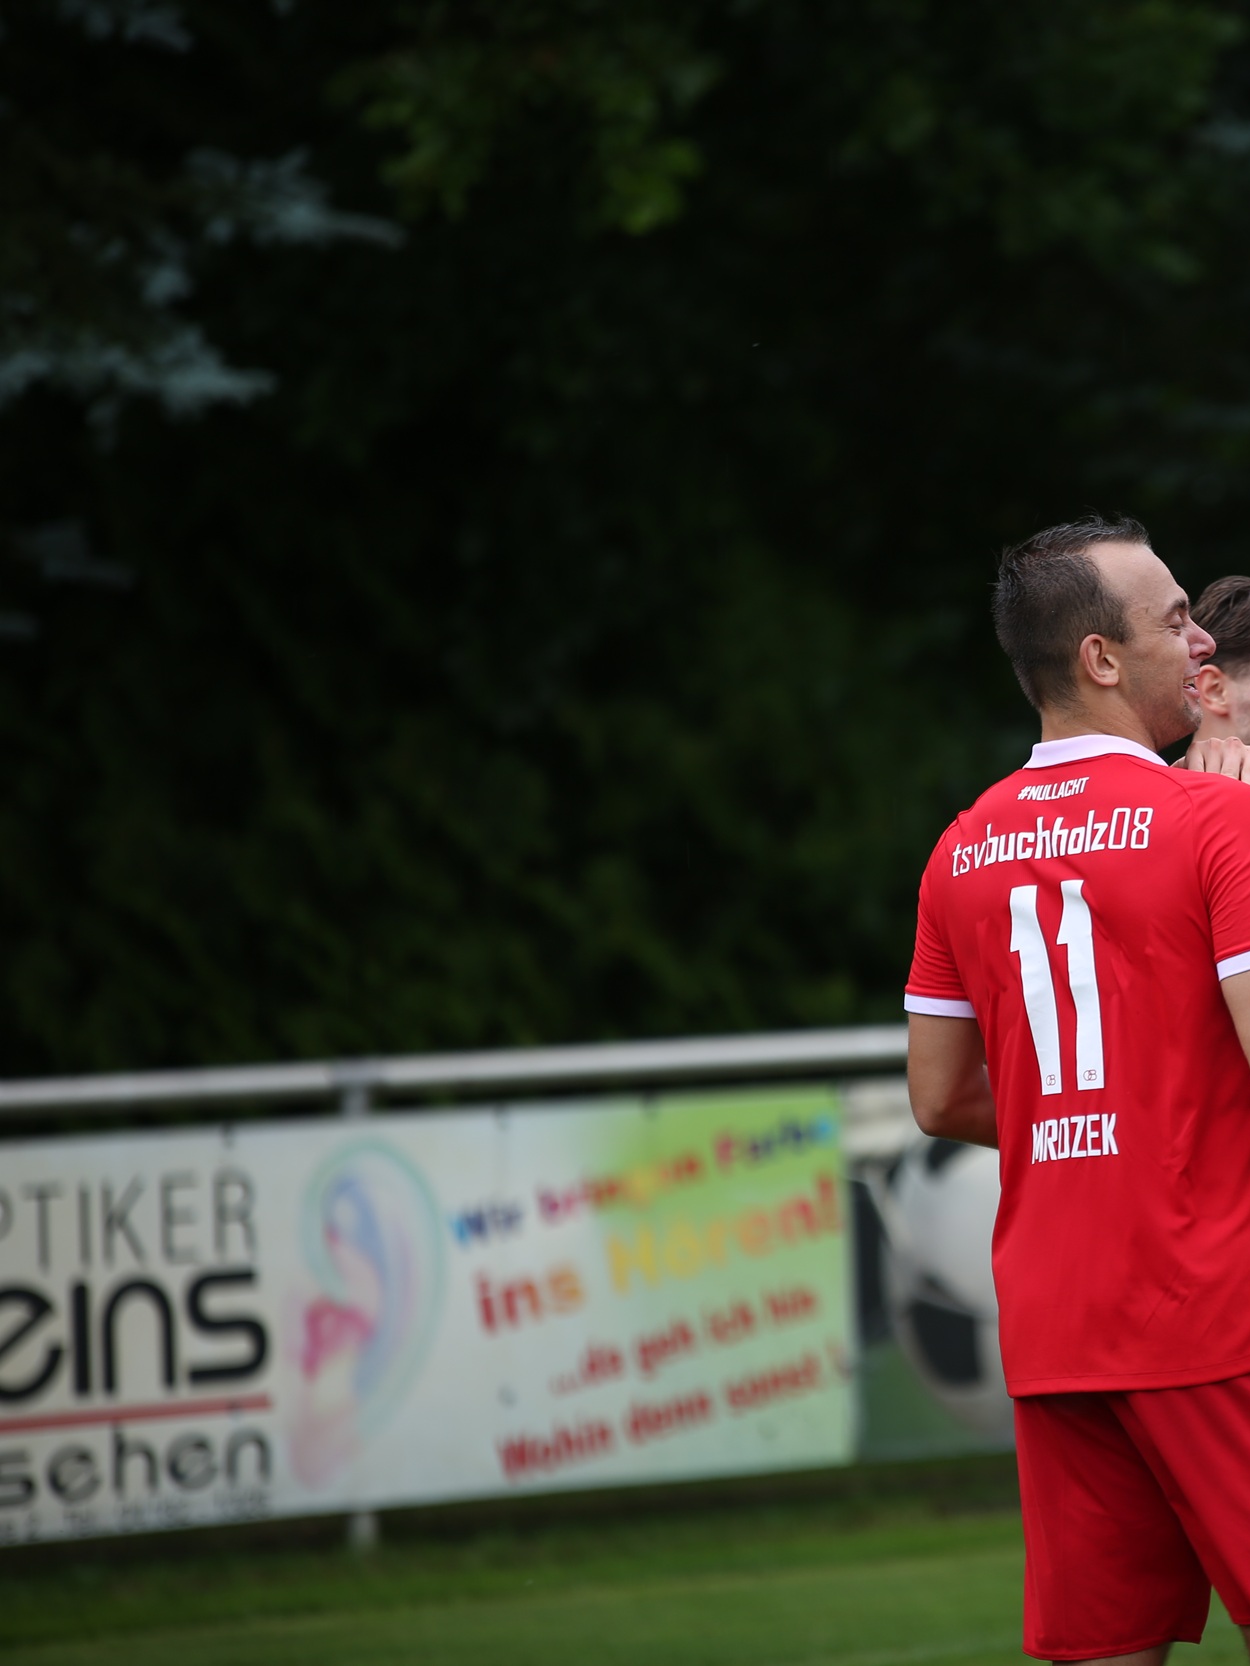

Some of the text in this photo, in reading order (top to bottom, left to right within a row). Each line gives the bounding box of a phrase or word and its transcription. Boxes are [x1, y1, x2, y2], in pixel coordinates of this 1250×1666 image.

[1017, 777, 1090, 801] #NULLACHT
[951, 807, 1154, 878] tsvbuchholz08
[1009, 879, 1105, 1096] 11
[1031, 1113, 1119, 1165] MROZEK
[0, 1168, 259, 1273] TIKER
[474, 1266, 586, 1337] ins
